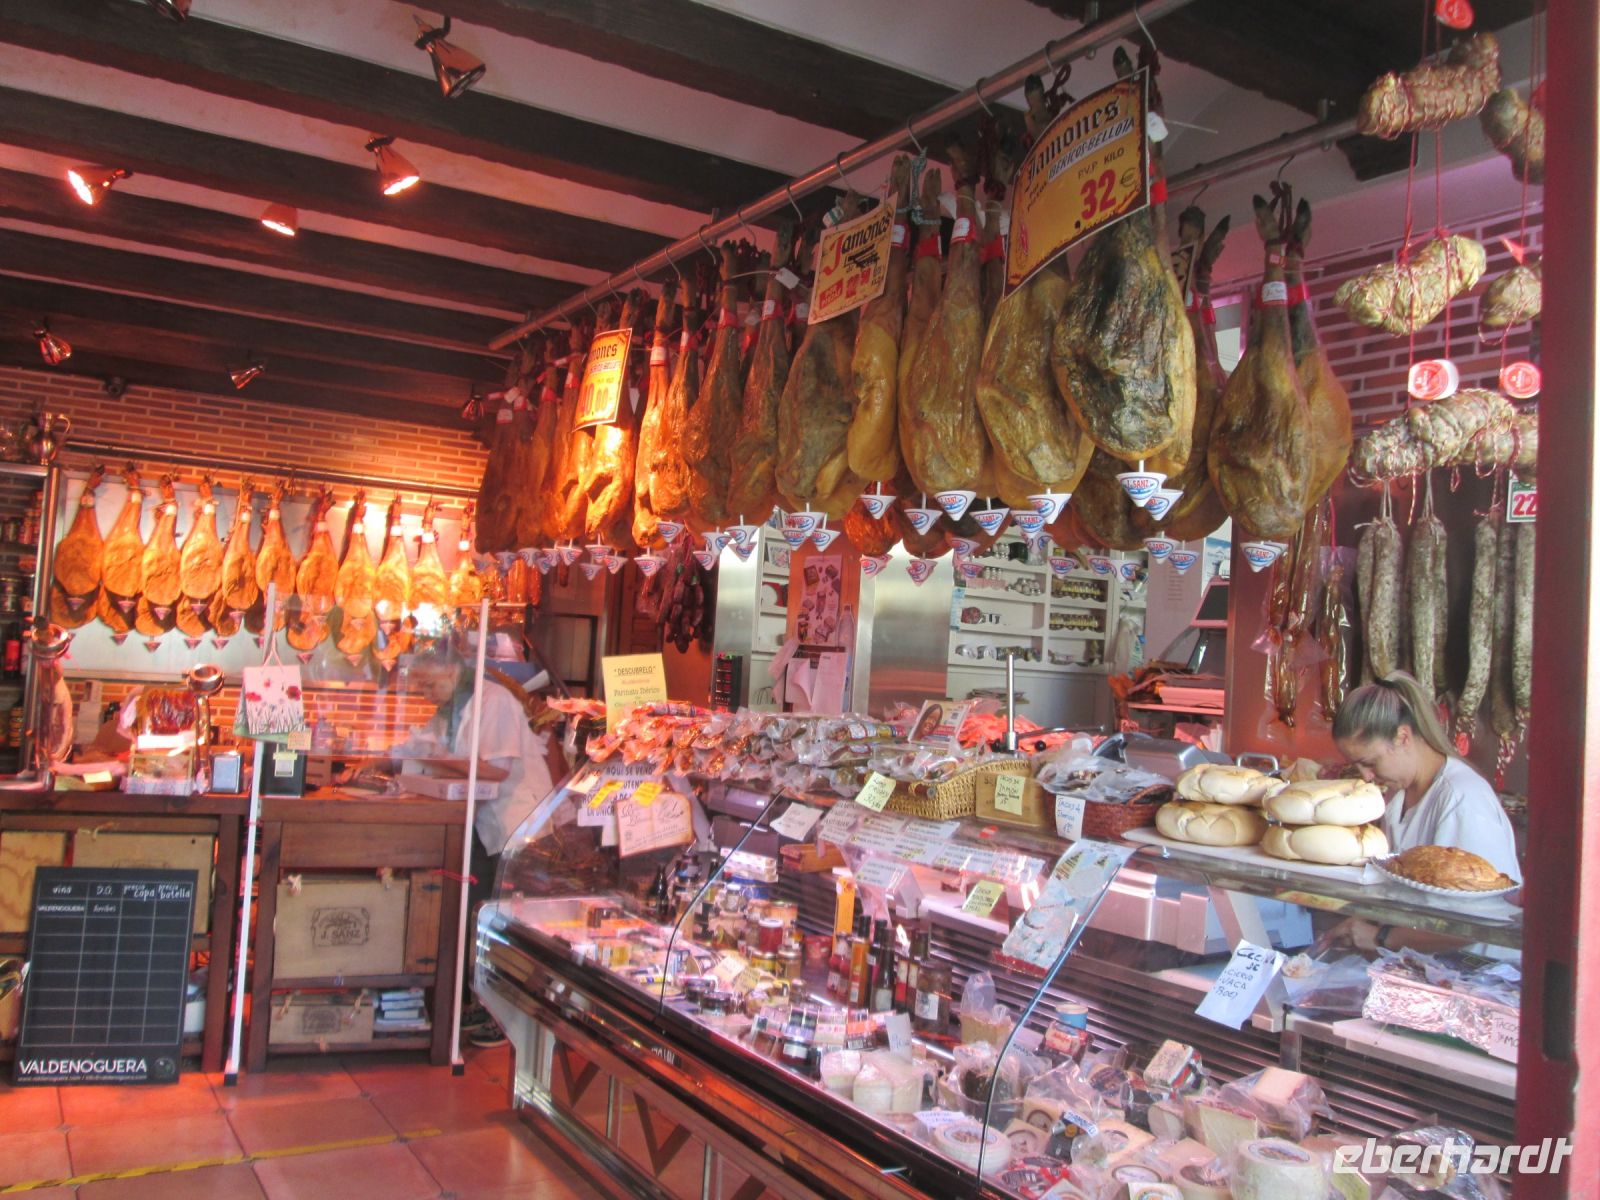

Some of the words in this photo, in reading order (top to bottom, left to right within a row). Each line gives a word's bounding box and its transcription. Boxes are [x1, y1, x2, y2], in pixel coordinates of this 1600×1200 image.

[1025, 97, 1120, 194] Jamones
[1103, 147, 1125, 165] KILO
[1080, 169, 1117, 220] 32
[823, 212, 892, 276] Jamones
[1513, 494, 1536, 515] 22
[625, 765, 633, 776] SE
[133, 887, 155, 901] copa
[161, 887, 190, 900] botella
[19, 1058, 147, 1075] VALDENOGUERA
